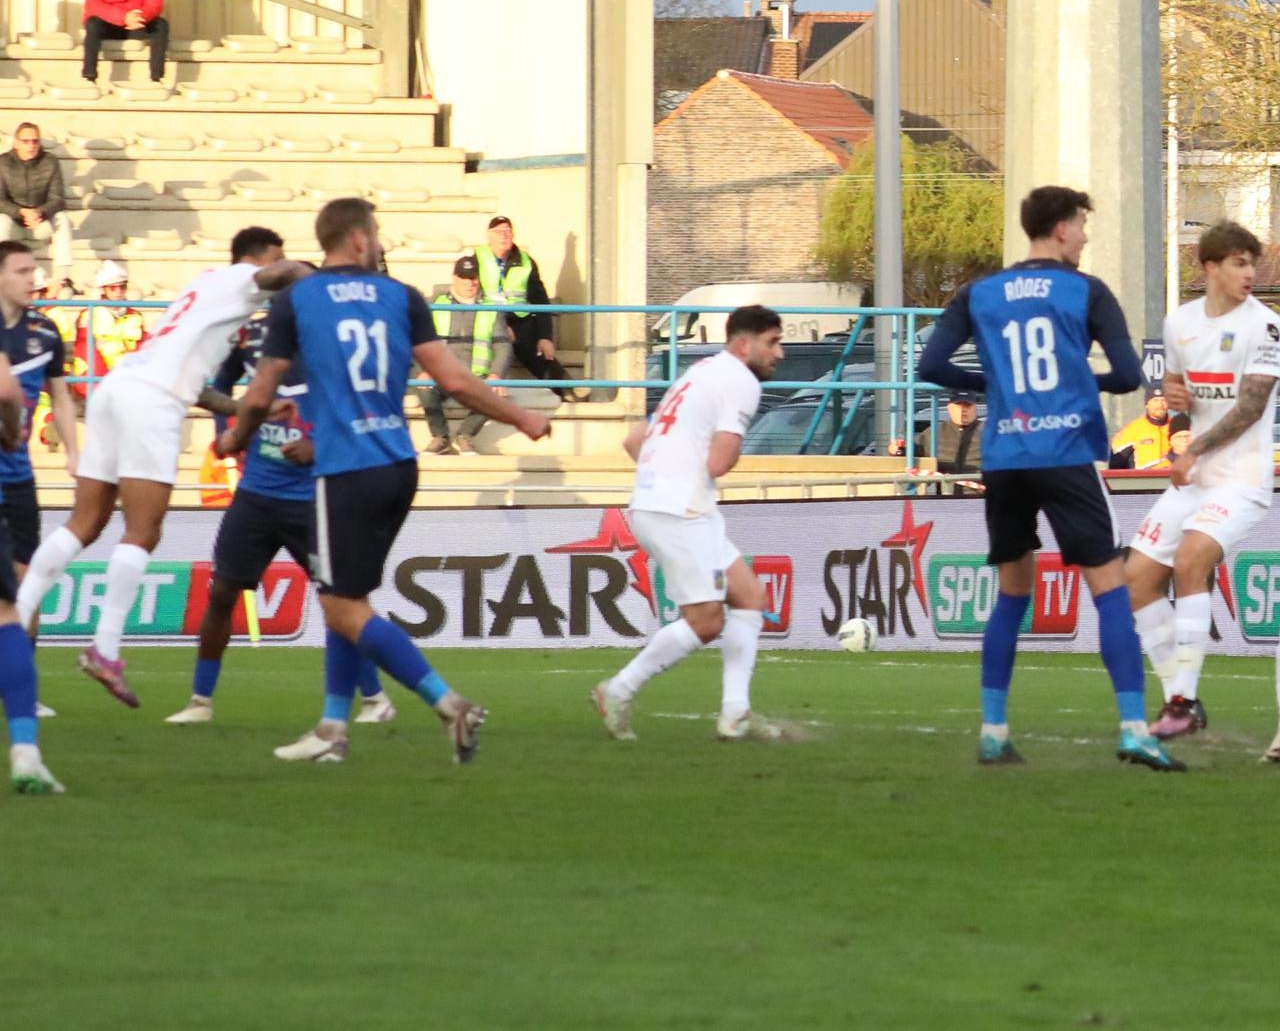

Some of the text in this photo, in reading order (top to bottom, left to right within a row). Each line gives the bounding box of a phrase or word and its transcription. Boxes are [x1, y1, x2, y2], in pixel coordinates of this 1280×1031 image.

[326, 282, 377, 303] COOLS
[336, 318, 388, 393] 21
[1002, 316, 1059, 394] 18
[1152, 353, 1165, 380] D
[1027, 413, 1081, 432] CASINO
[1136, 517, 1164, 547] 44
[40, 572, 176, 625] ORT
[389, 552, 646, 639] STAR
[821, 546, 916, 638] STAR
[937, 565, 999, 622] SPO
[1042, 571, 1074, 616] TV
